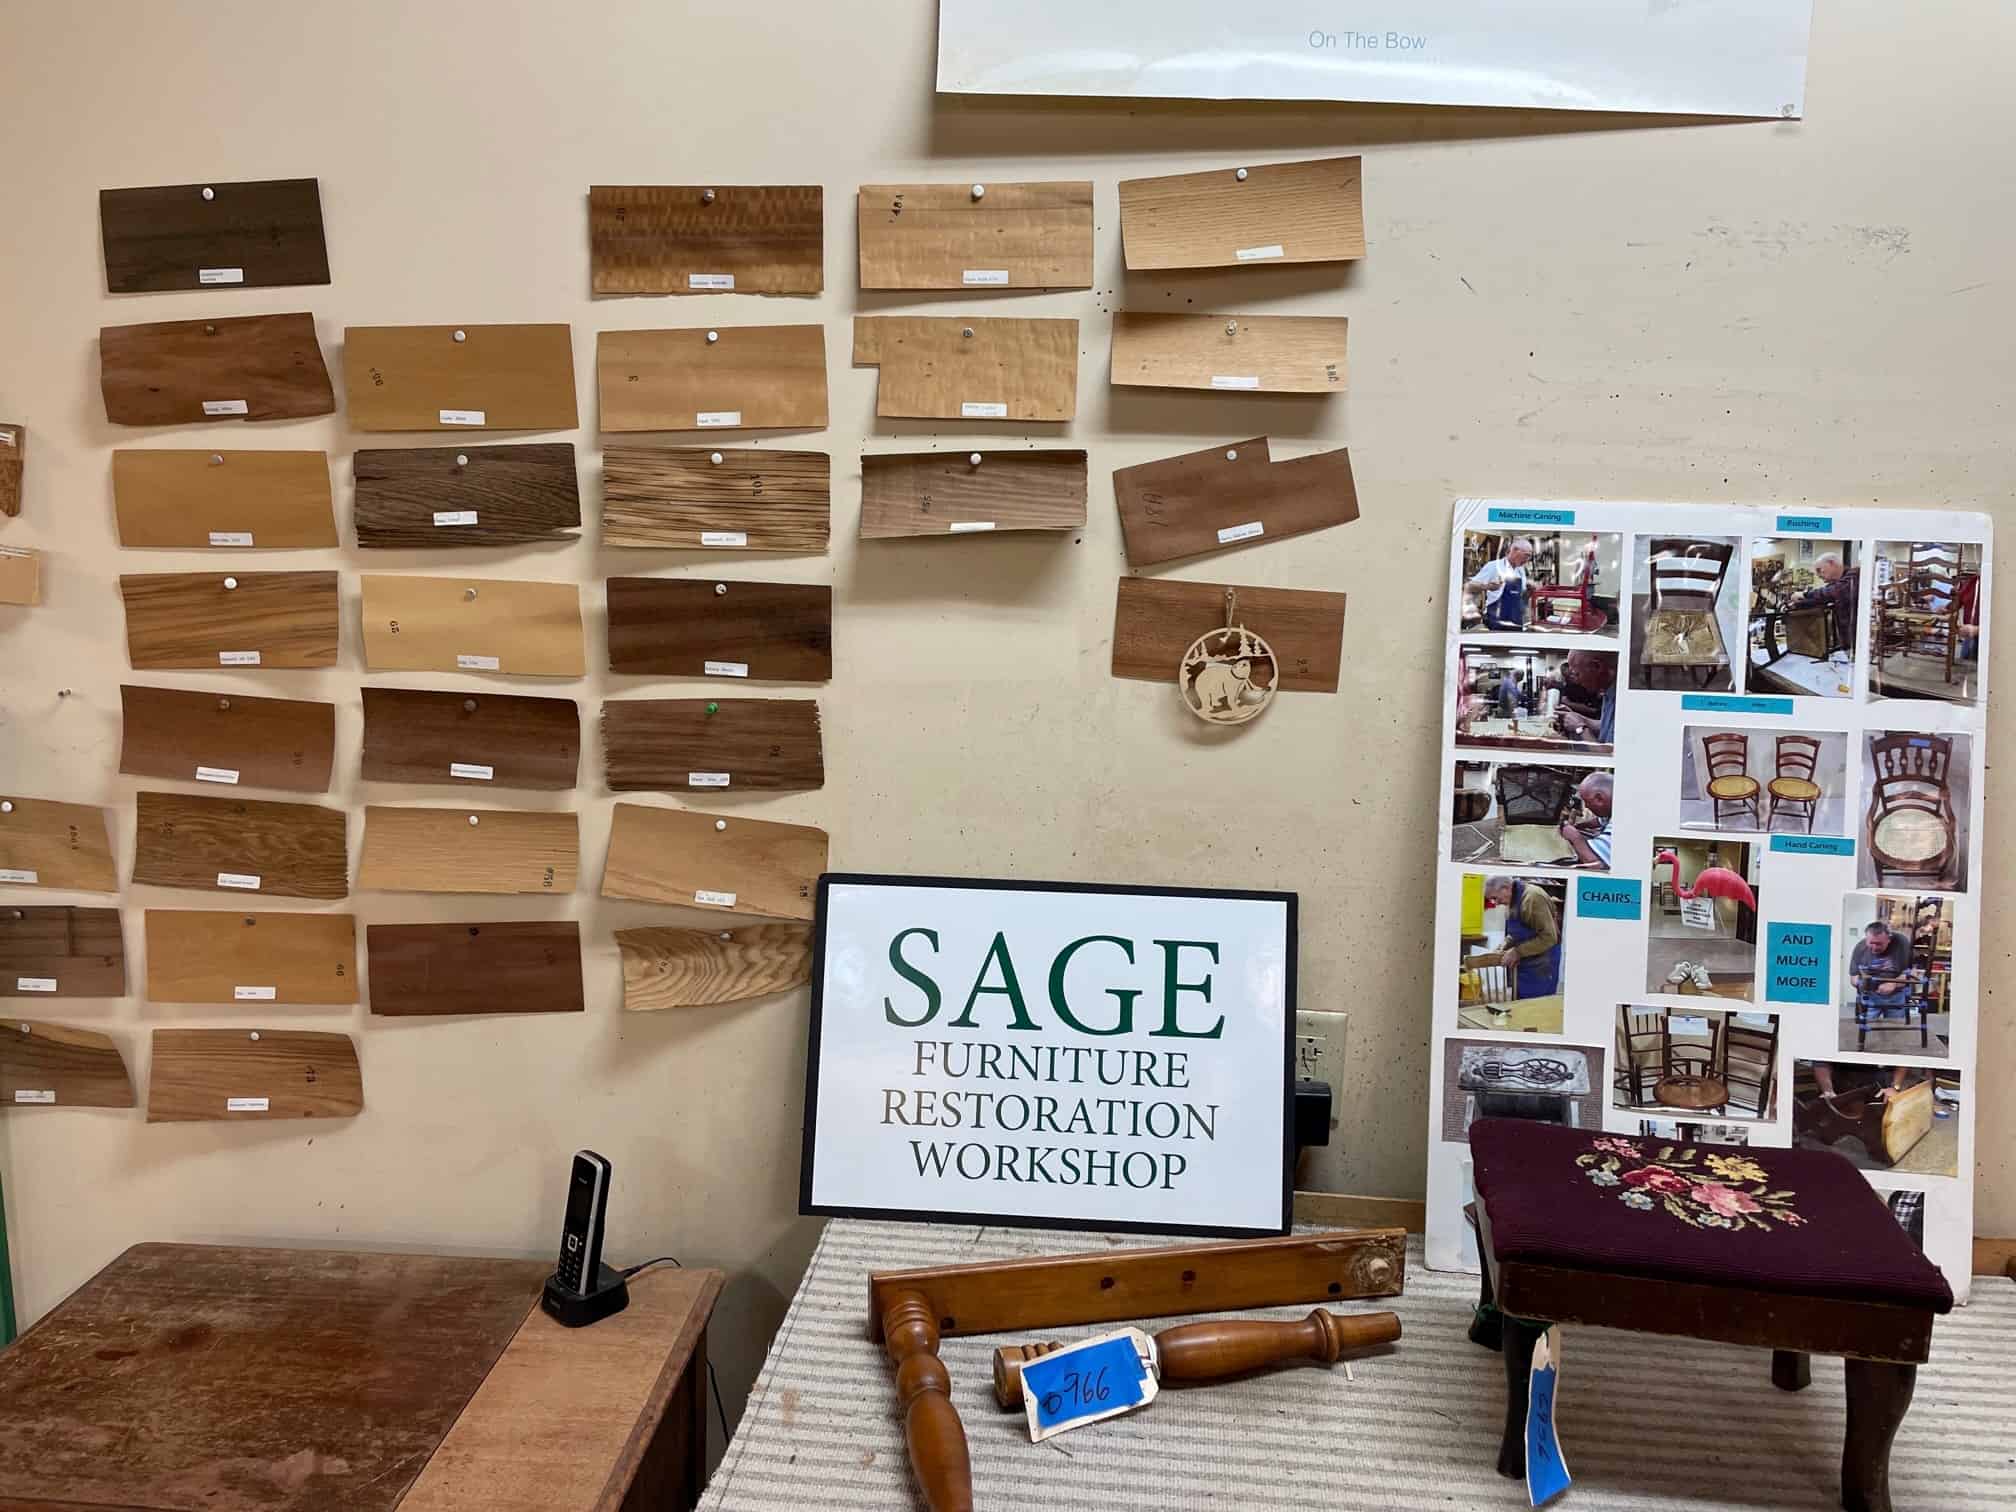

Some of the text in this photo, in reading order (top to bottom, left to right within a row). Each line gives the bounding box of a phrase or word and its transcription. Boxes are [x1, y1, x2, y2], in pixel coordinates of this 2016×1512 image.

[1308, 30, 1427, 49] On The Bow
[1498, 511, 1561, 522] Machine Caning
[1785, 841, 1838, 852] Hand Caning
[1781, 934, 1815, 946] AND
[1775, 954, 1819, 968] MUCH
[884, 927, 1226, 1040] SAGE
[1775, 975, 1818, 989] MORE
[911, 1040, 1191, 1089] FURNITURE
[879, 1088, 1220, 1142] RESTORATION
[909, 1140, 1188, 1190] WORKSHOP
